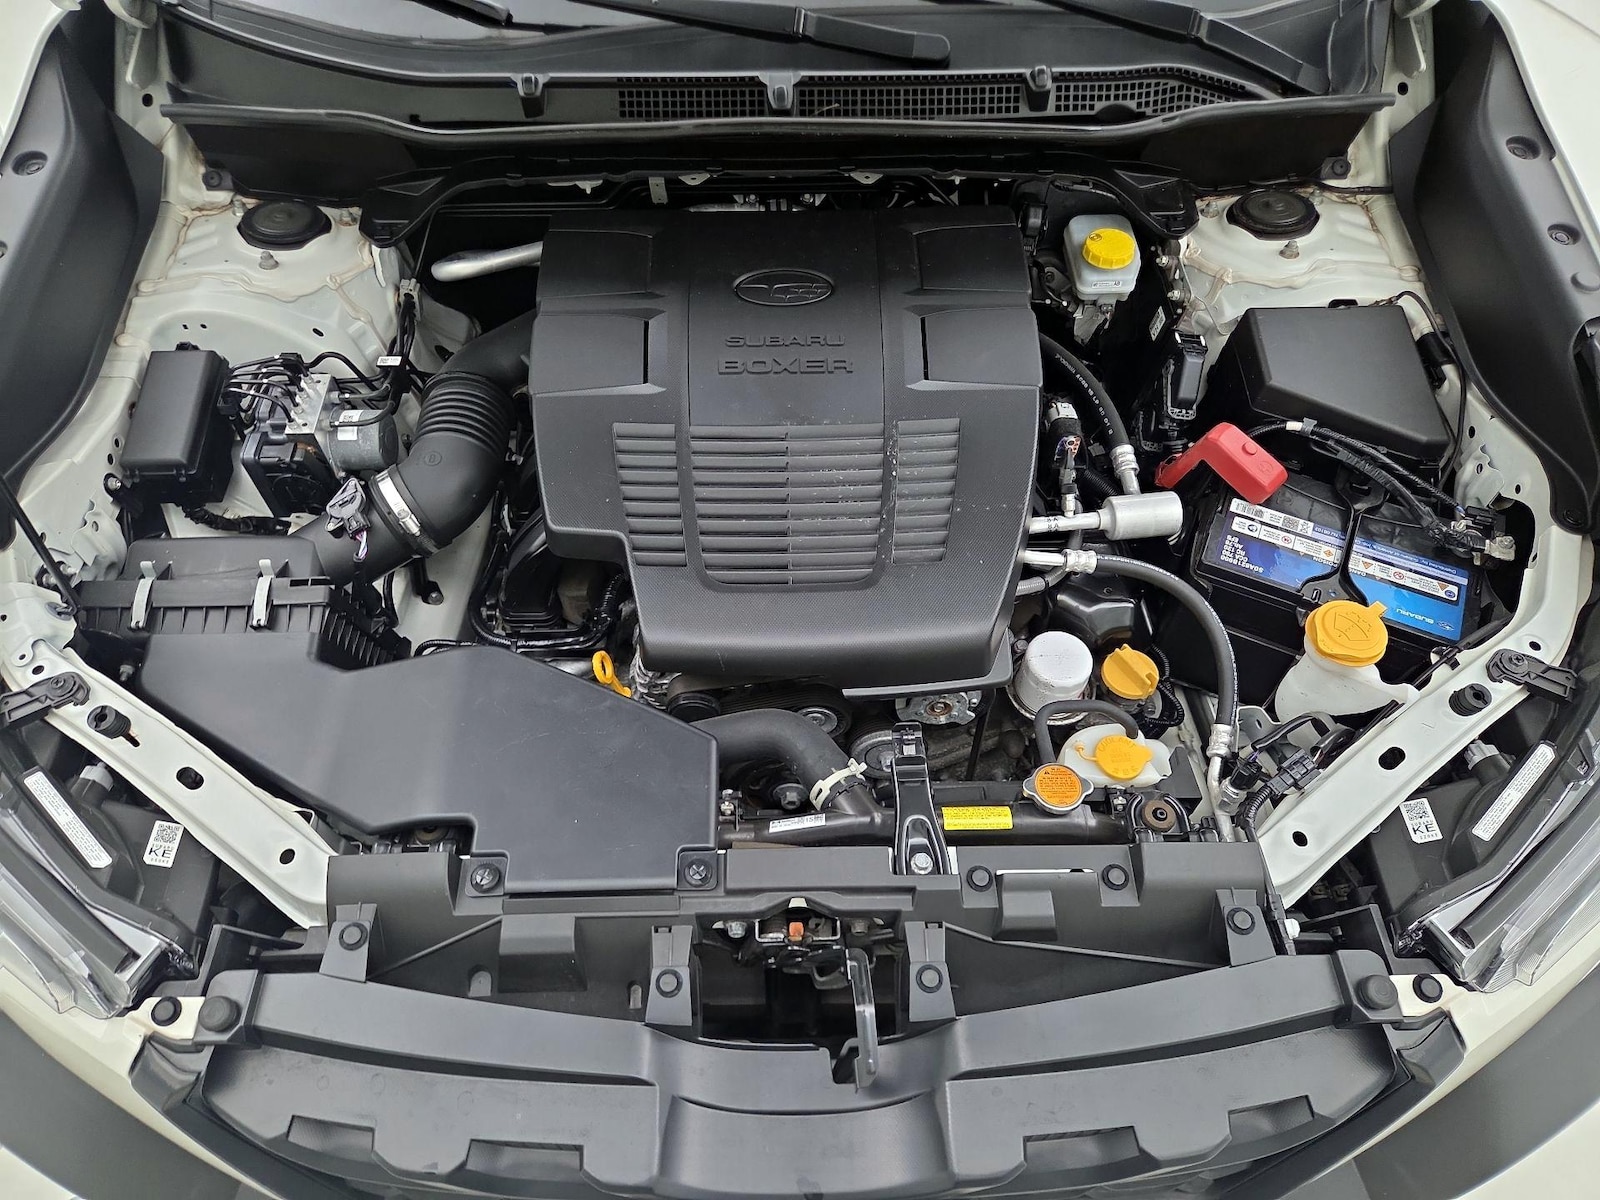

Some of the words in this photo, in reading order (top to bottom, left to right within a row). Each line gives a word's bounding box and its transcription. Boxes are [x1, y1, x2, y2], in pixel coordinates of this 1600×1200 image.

[724, 333, 846, 348] SUBARU
[717, 357, 854, 376] BOXER
[1312, 557, 1337, 567] POISON
[1395, 607, 1435, 624] SUBARU
[1412, 823, 1436, 835] KE
[148, 847, 172, 858] KE
